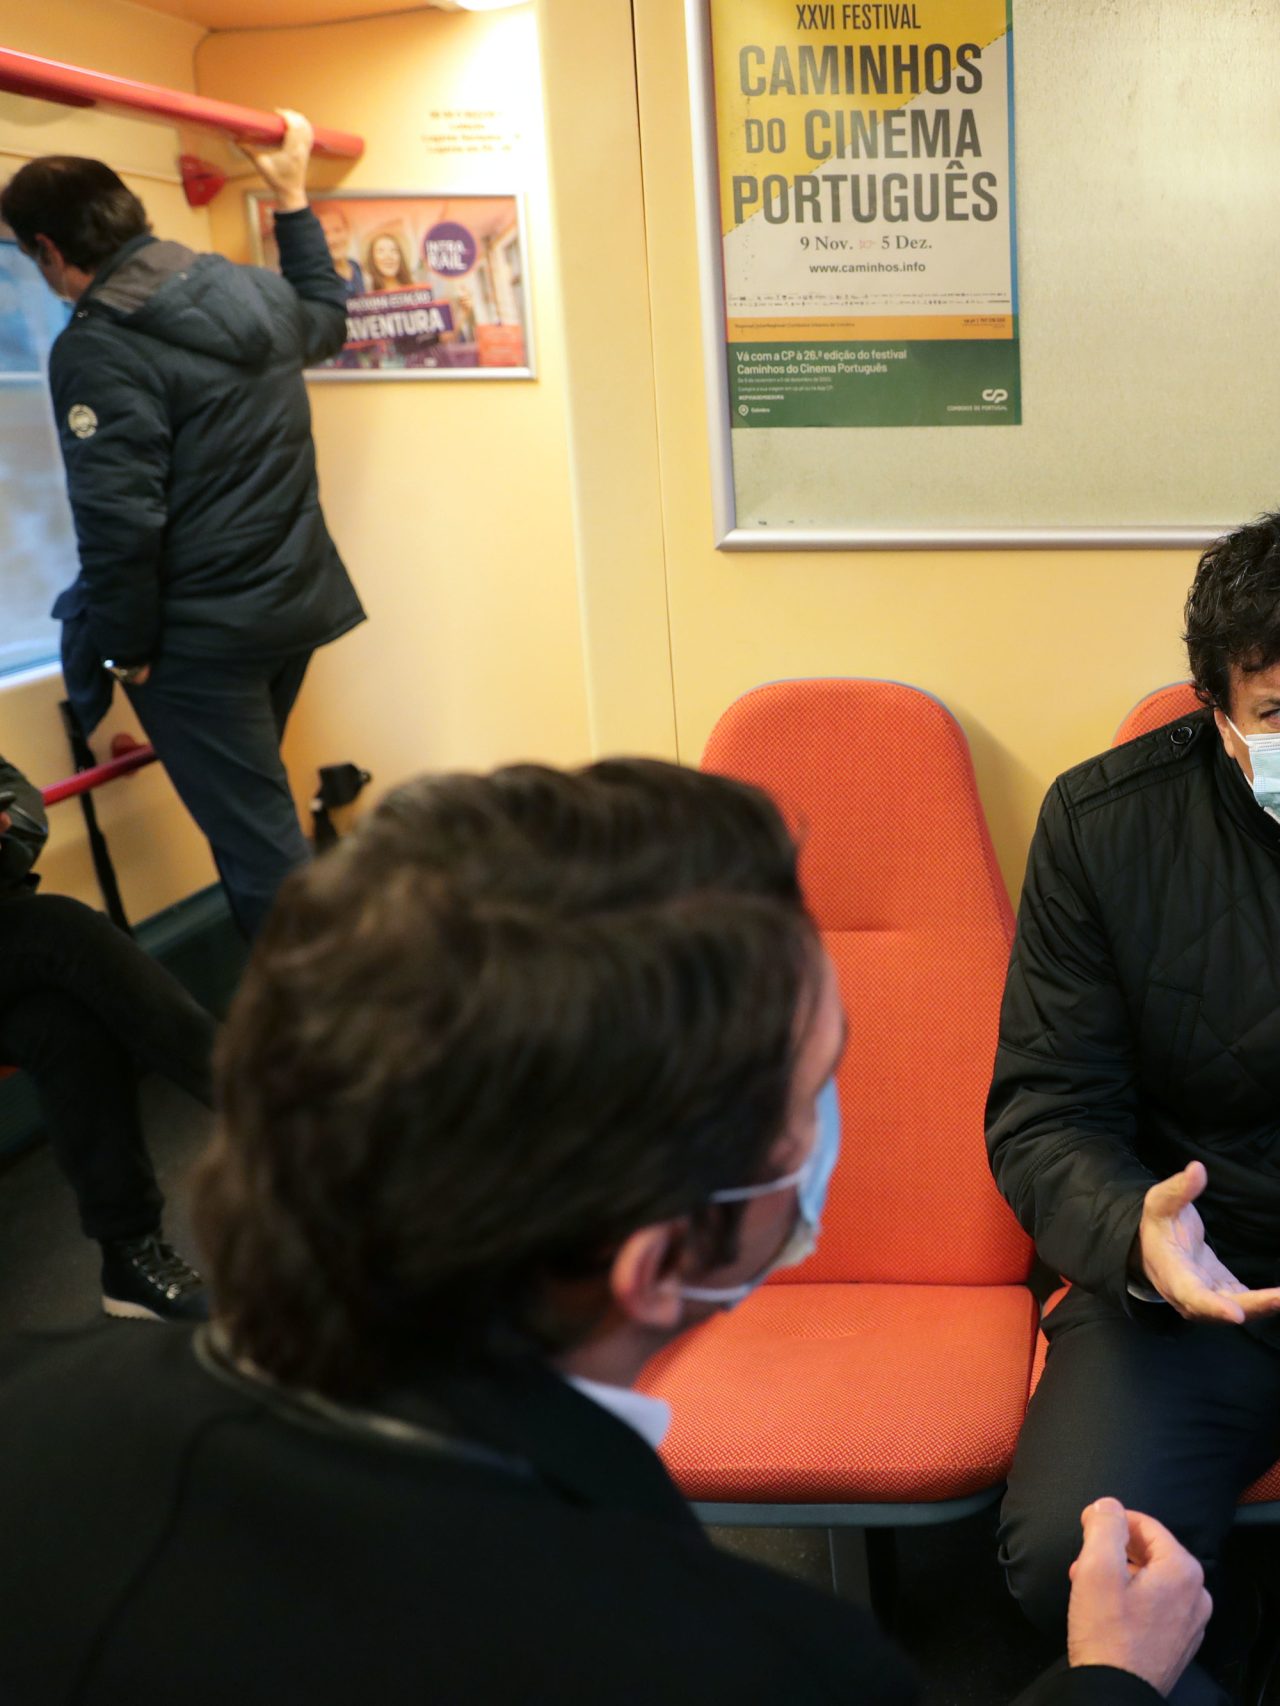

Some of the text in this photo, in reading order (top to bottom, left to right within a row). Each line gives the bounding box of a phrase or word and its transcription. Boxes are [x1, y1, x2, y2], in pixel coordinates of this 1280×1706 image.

[796, 3, 921, 30] XXVI FESTIVAL
[739, 43, 983, 97] CAMINHOS
[744, 108, 982, 160] DO CINEMA
[732, 160, 998, 225] PORTUGUÊS
[800, 234, 933, 250] 9 Nov. 5 Dez.
[428, 252, 468, 271] RAIL
[809, 261, 926, 273] www.caminhos.info
[736, 351, 749, 361] Vá
[750, 352, 772, 361] com
[773, 353, 780, 361] a
[781, 350, 795, 361] CP
[823, 349, 856, 361] edição
[857, 349, 870, 360] do
[871, 348, 907, 360] festival
[737, 362, 888, 376] Caminhos do Cinema Português
